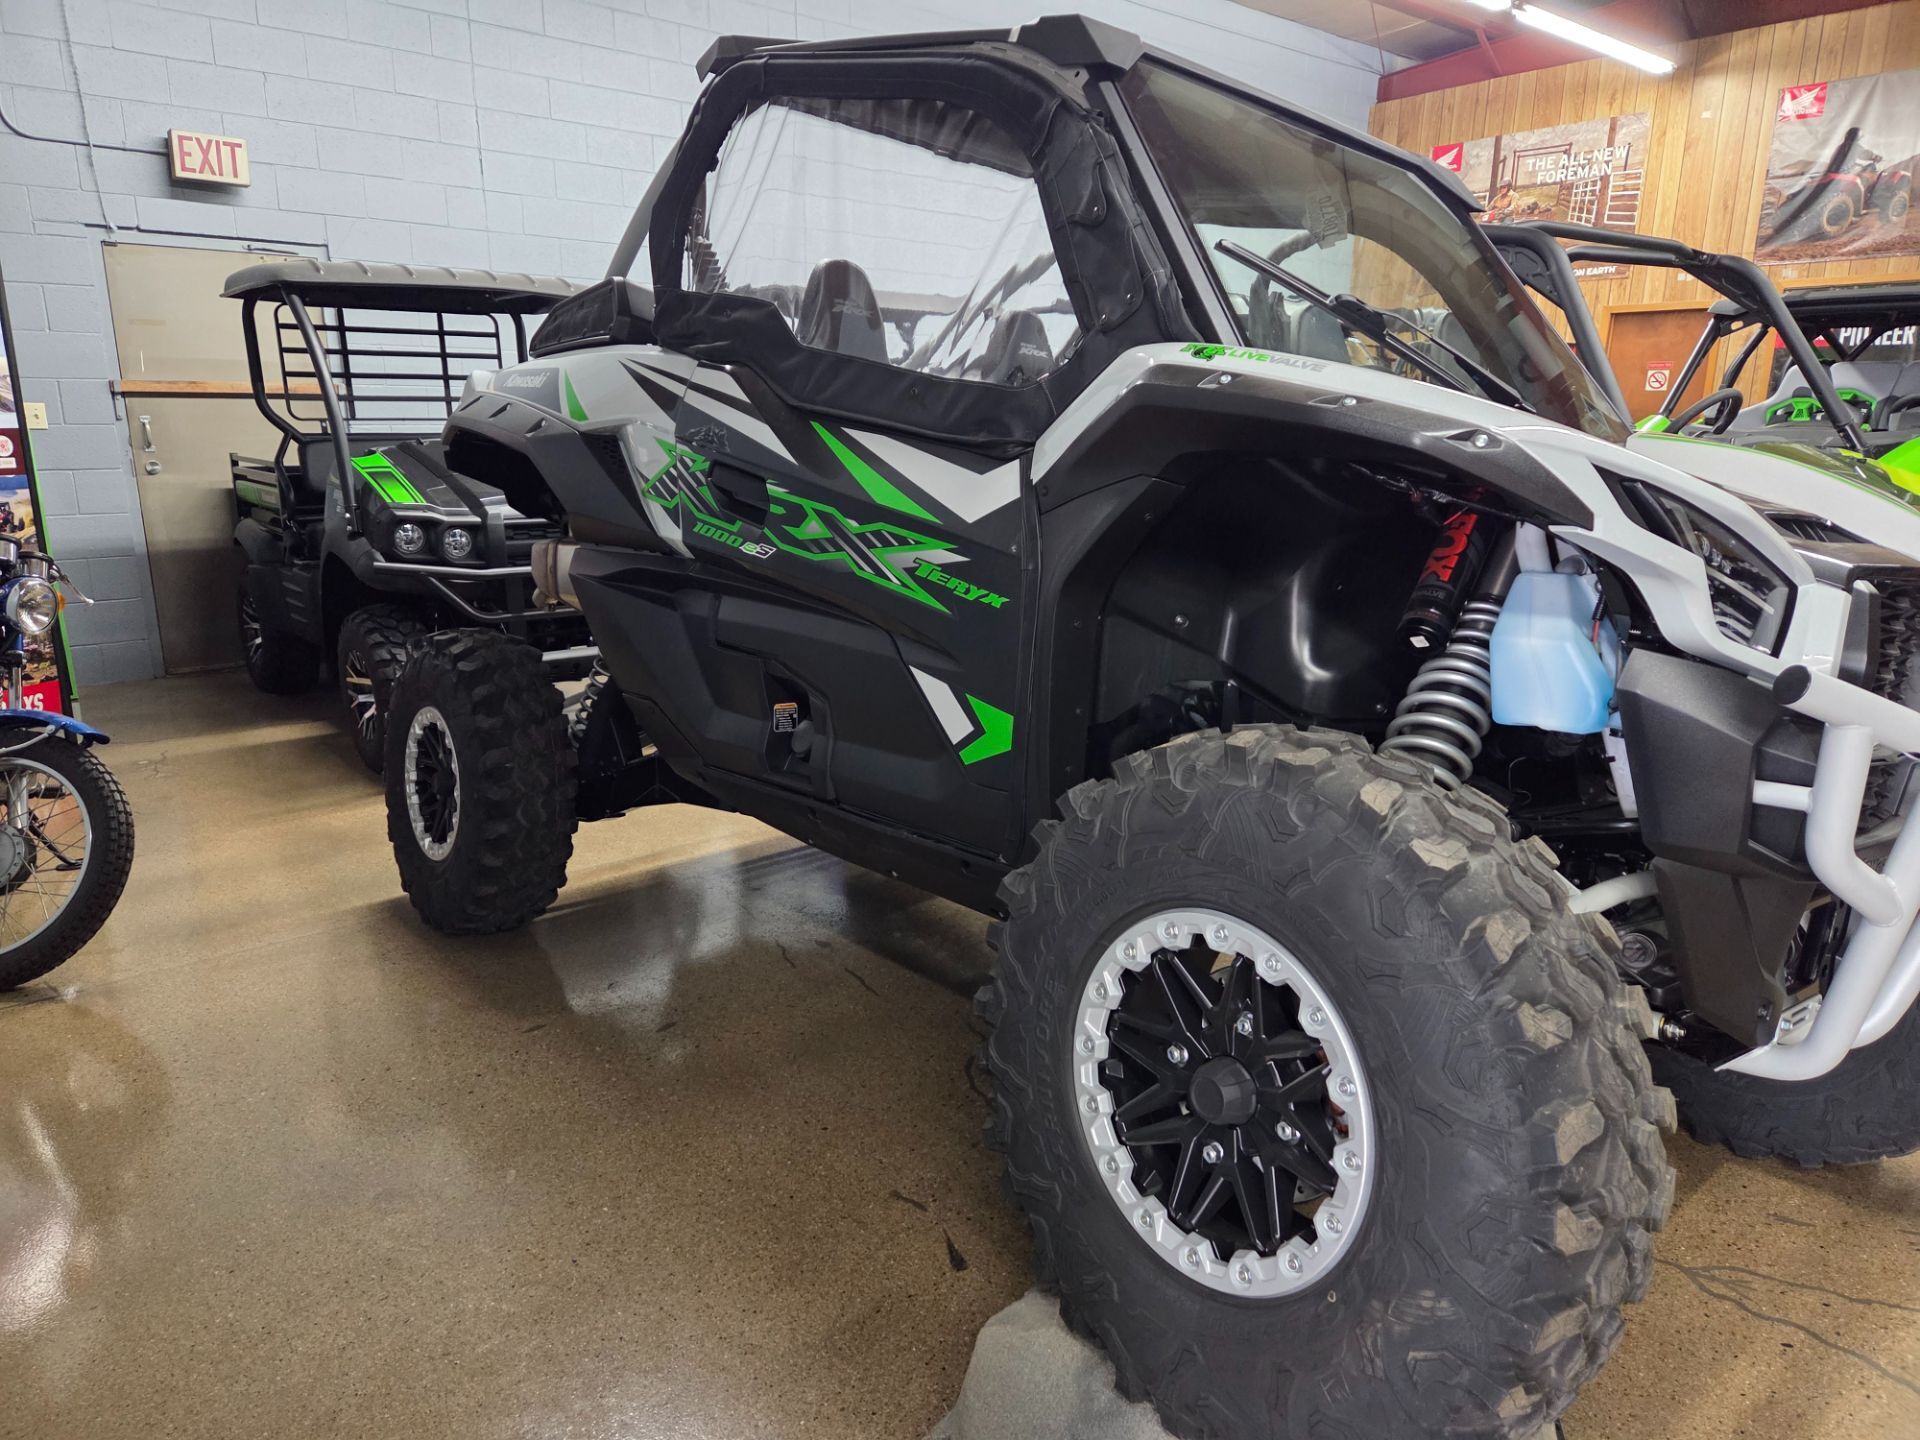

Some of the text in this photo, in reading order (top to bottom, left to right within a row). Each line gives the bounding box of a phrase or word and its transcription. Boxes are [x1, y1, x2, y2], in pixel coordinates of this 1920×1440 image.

[177, 134, 243, 178] EXIT
[1526, 145, 1630, 172] THE ALL-NEW
[1536, 162, 1614, 185] FOREMAN
[1586, 265, 1618, 276] EARTH
[1838, 325, 1919, 347] PIOEER
[693, 521, 744, 548] 1000
